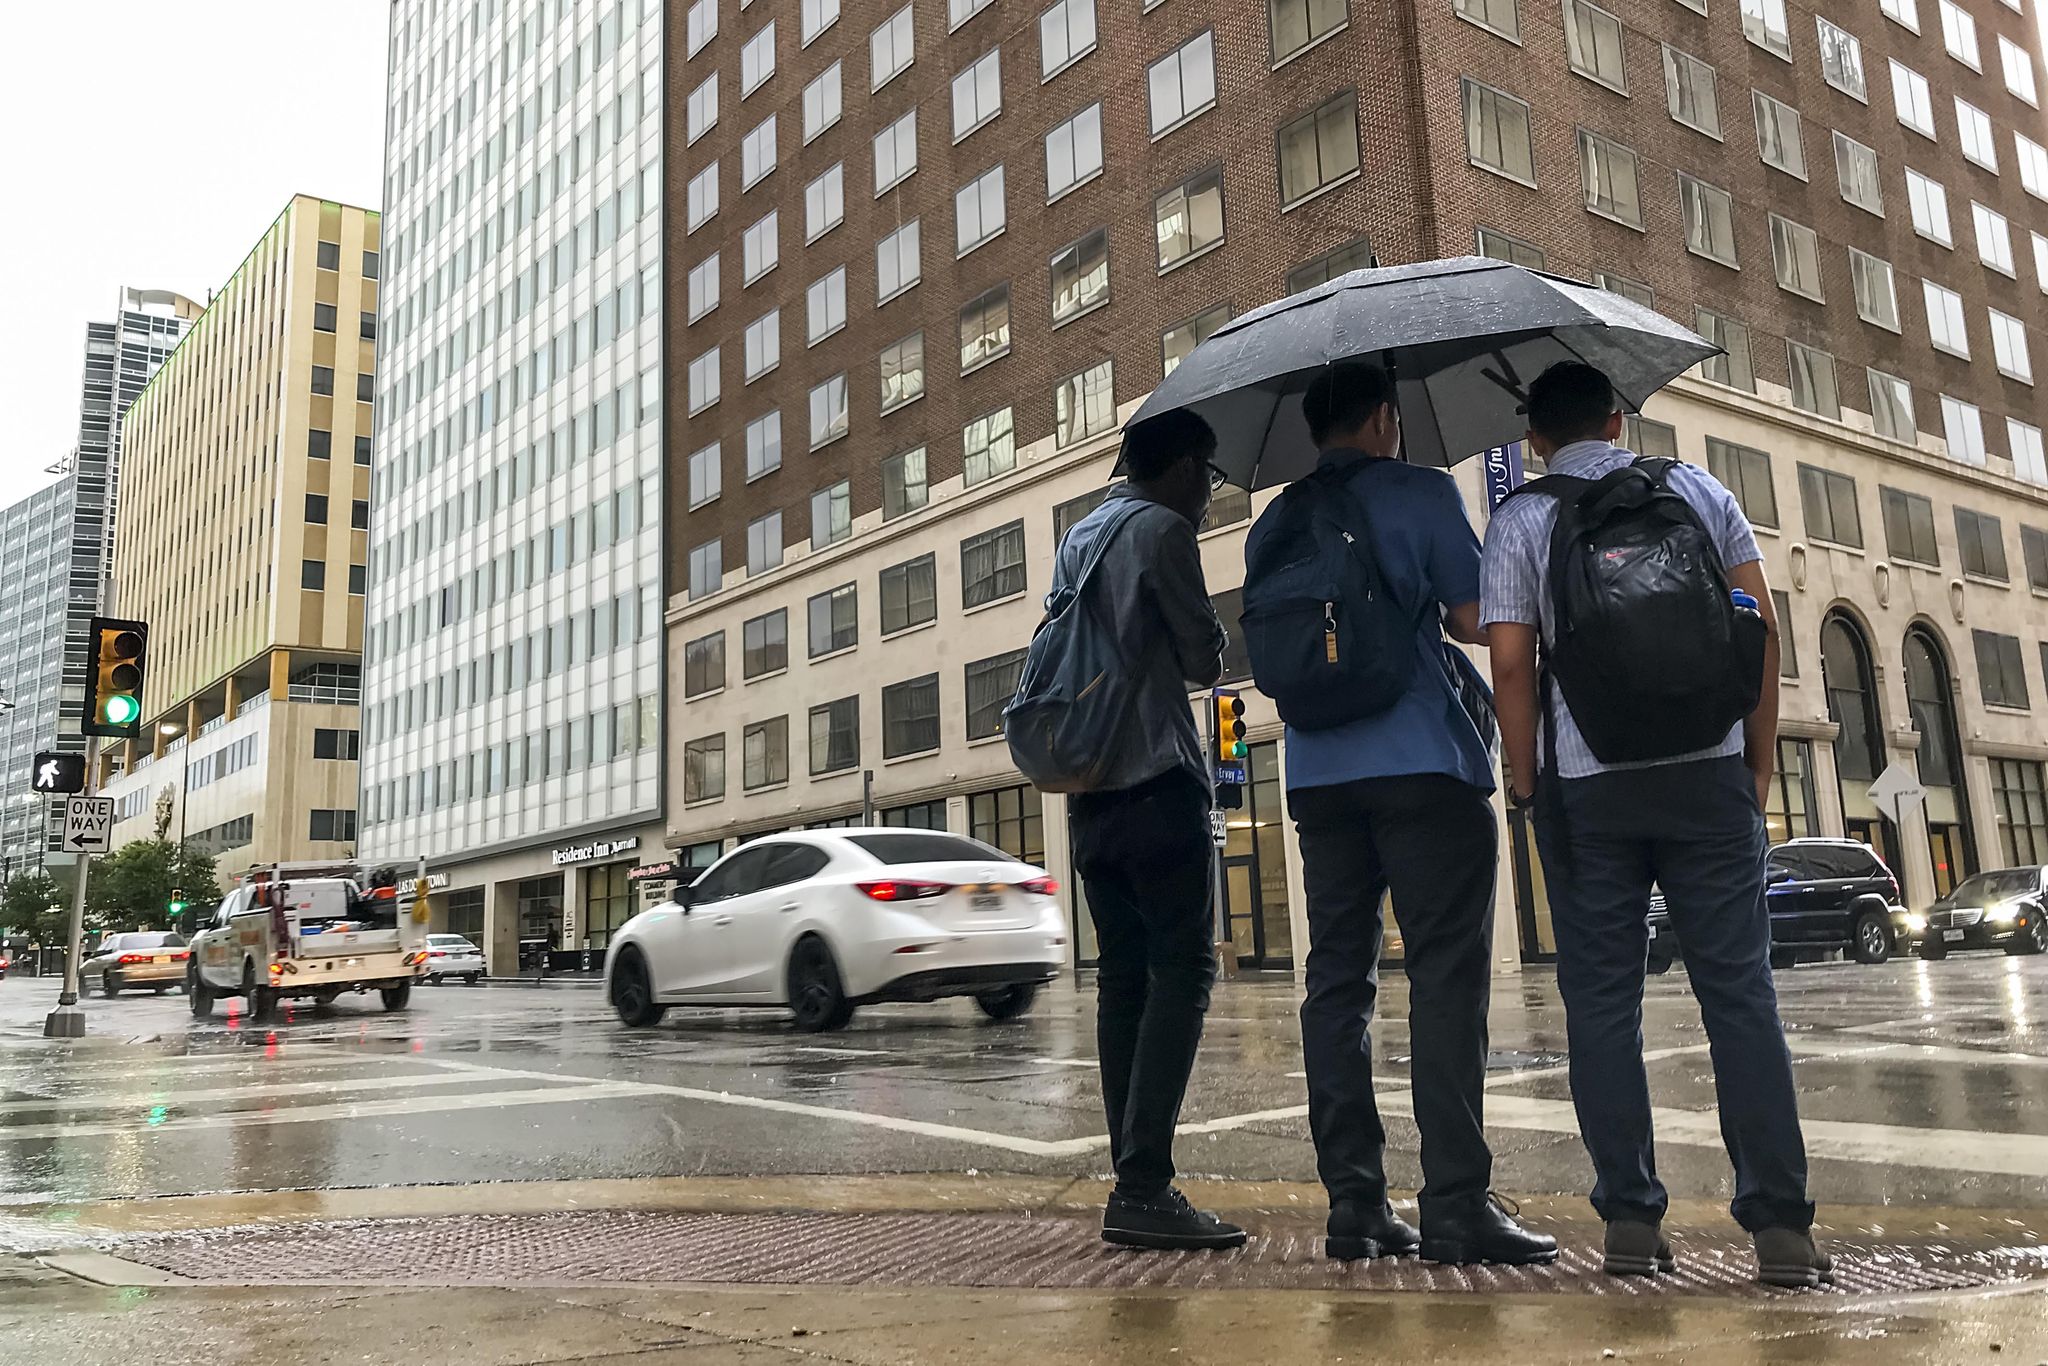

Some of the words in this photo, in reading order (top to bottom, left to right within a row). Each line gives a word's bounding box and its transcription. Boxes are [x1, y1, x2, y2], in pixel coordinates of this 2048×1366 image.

[73, 801, 108, 816] ONE
[71, 817, 107, 831] WAY
[1209, 812, 1224, 822] ONE
[552, 846, 592, 865] Residence
[593, 842, 609, 858] Inn
[408, 873, 447, 892] DOTOWN
